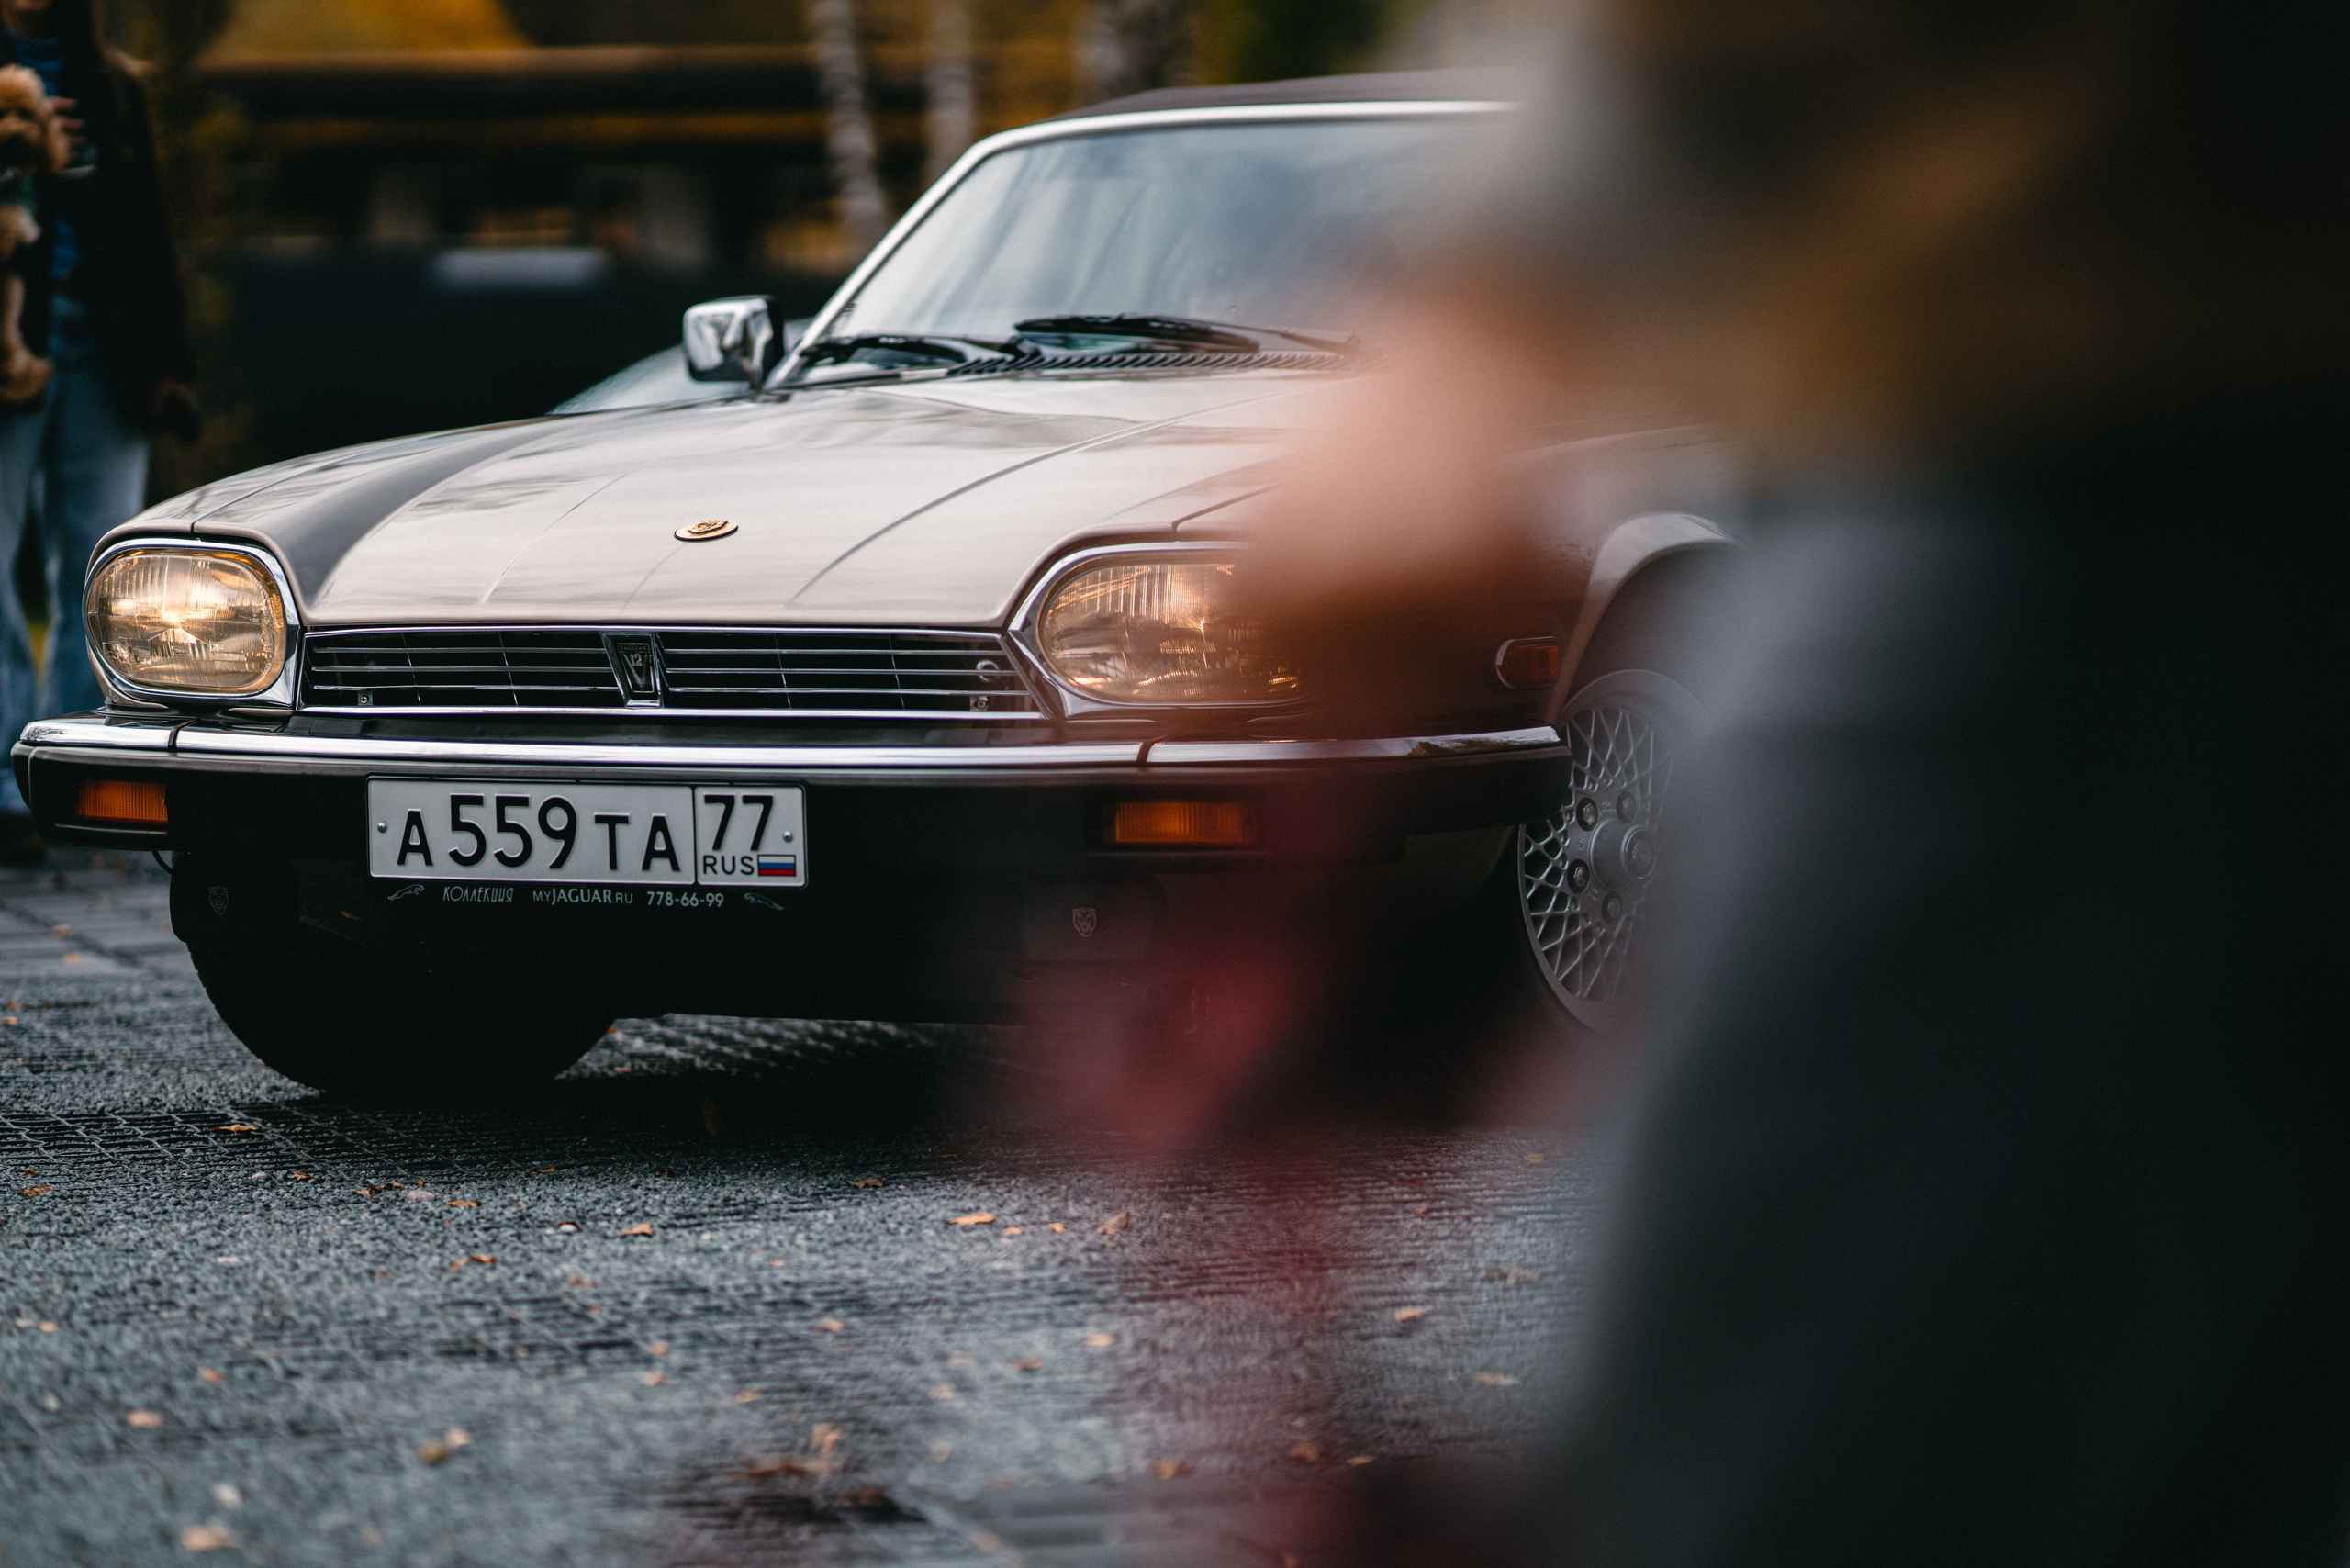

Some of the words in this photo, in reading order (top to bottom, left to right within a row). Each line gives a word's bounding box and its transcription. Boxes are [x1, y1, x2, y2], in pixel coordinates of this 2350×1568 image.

[703, 794, 774, 851] 77
[702, 855, 755, 875] RUS
[442, 885, 514, 902] КОЛЛЕКЦИЯ
[646, 891, 724, 908] 778-66-99
